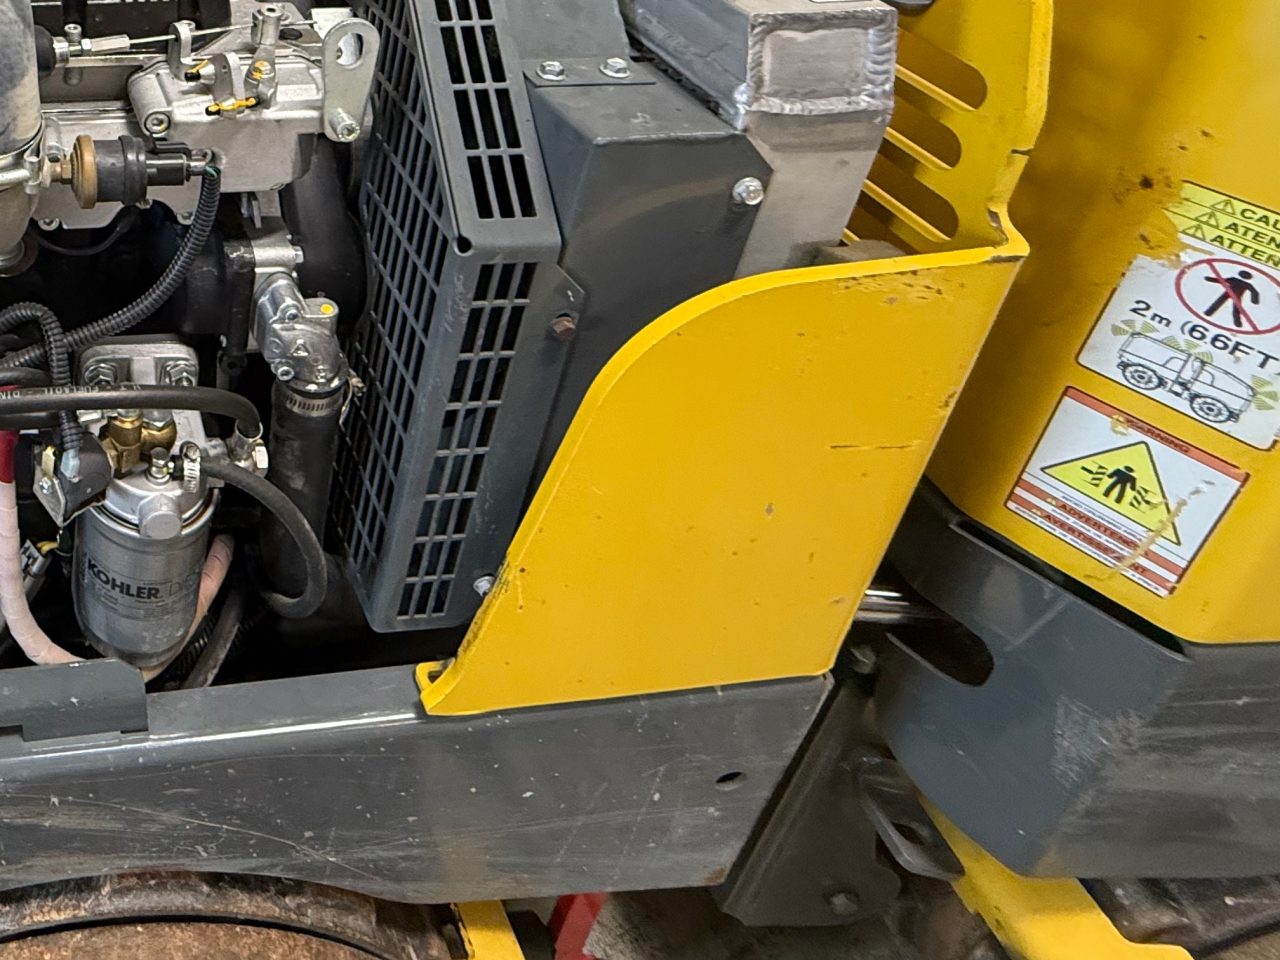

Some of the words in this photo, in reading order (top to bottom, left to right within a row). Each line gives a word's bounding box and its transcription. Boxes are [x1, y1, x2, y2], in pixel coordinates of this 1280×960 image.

[1180, 320, 1280, 371] (6.6FT
[1042, 512, 1146, 575] AVERTISSEMNT
[1058, 502, 1149, 557] ADVERTENCA
[87, 557, 161, 600] KOHLER
